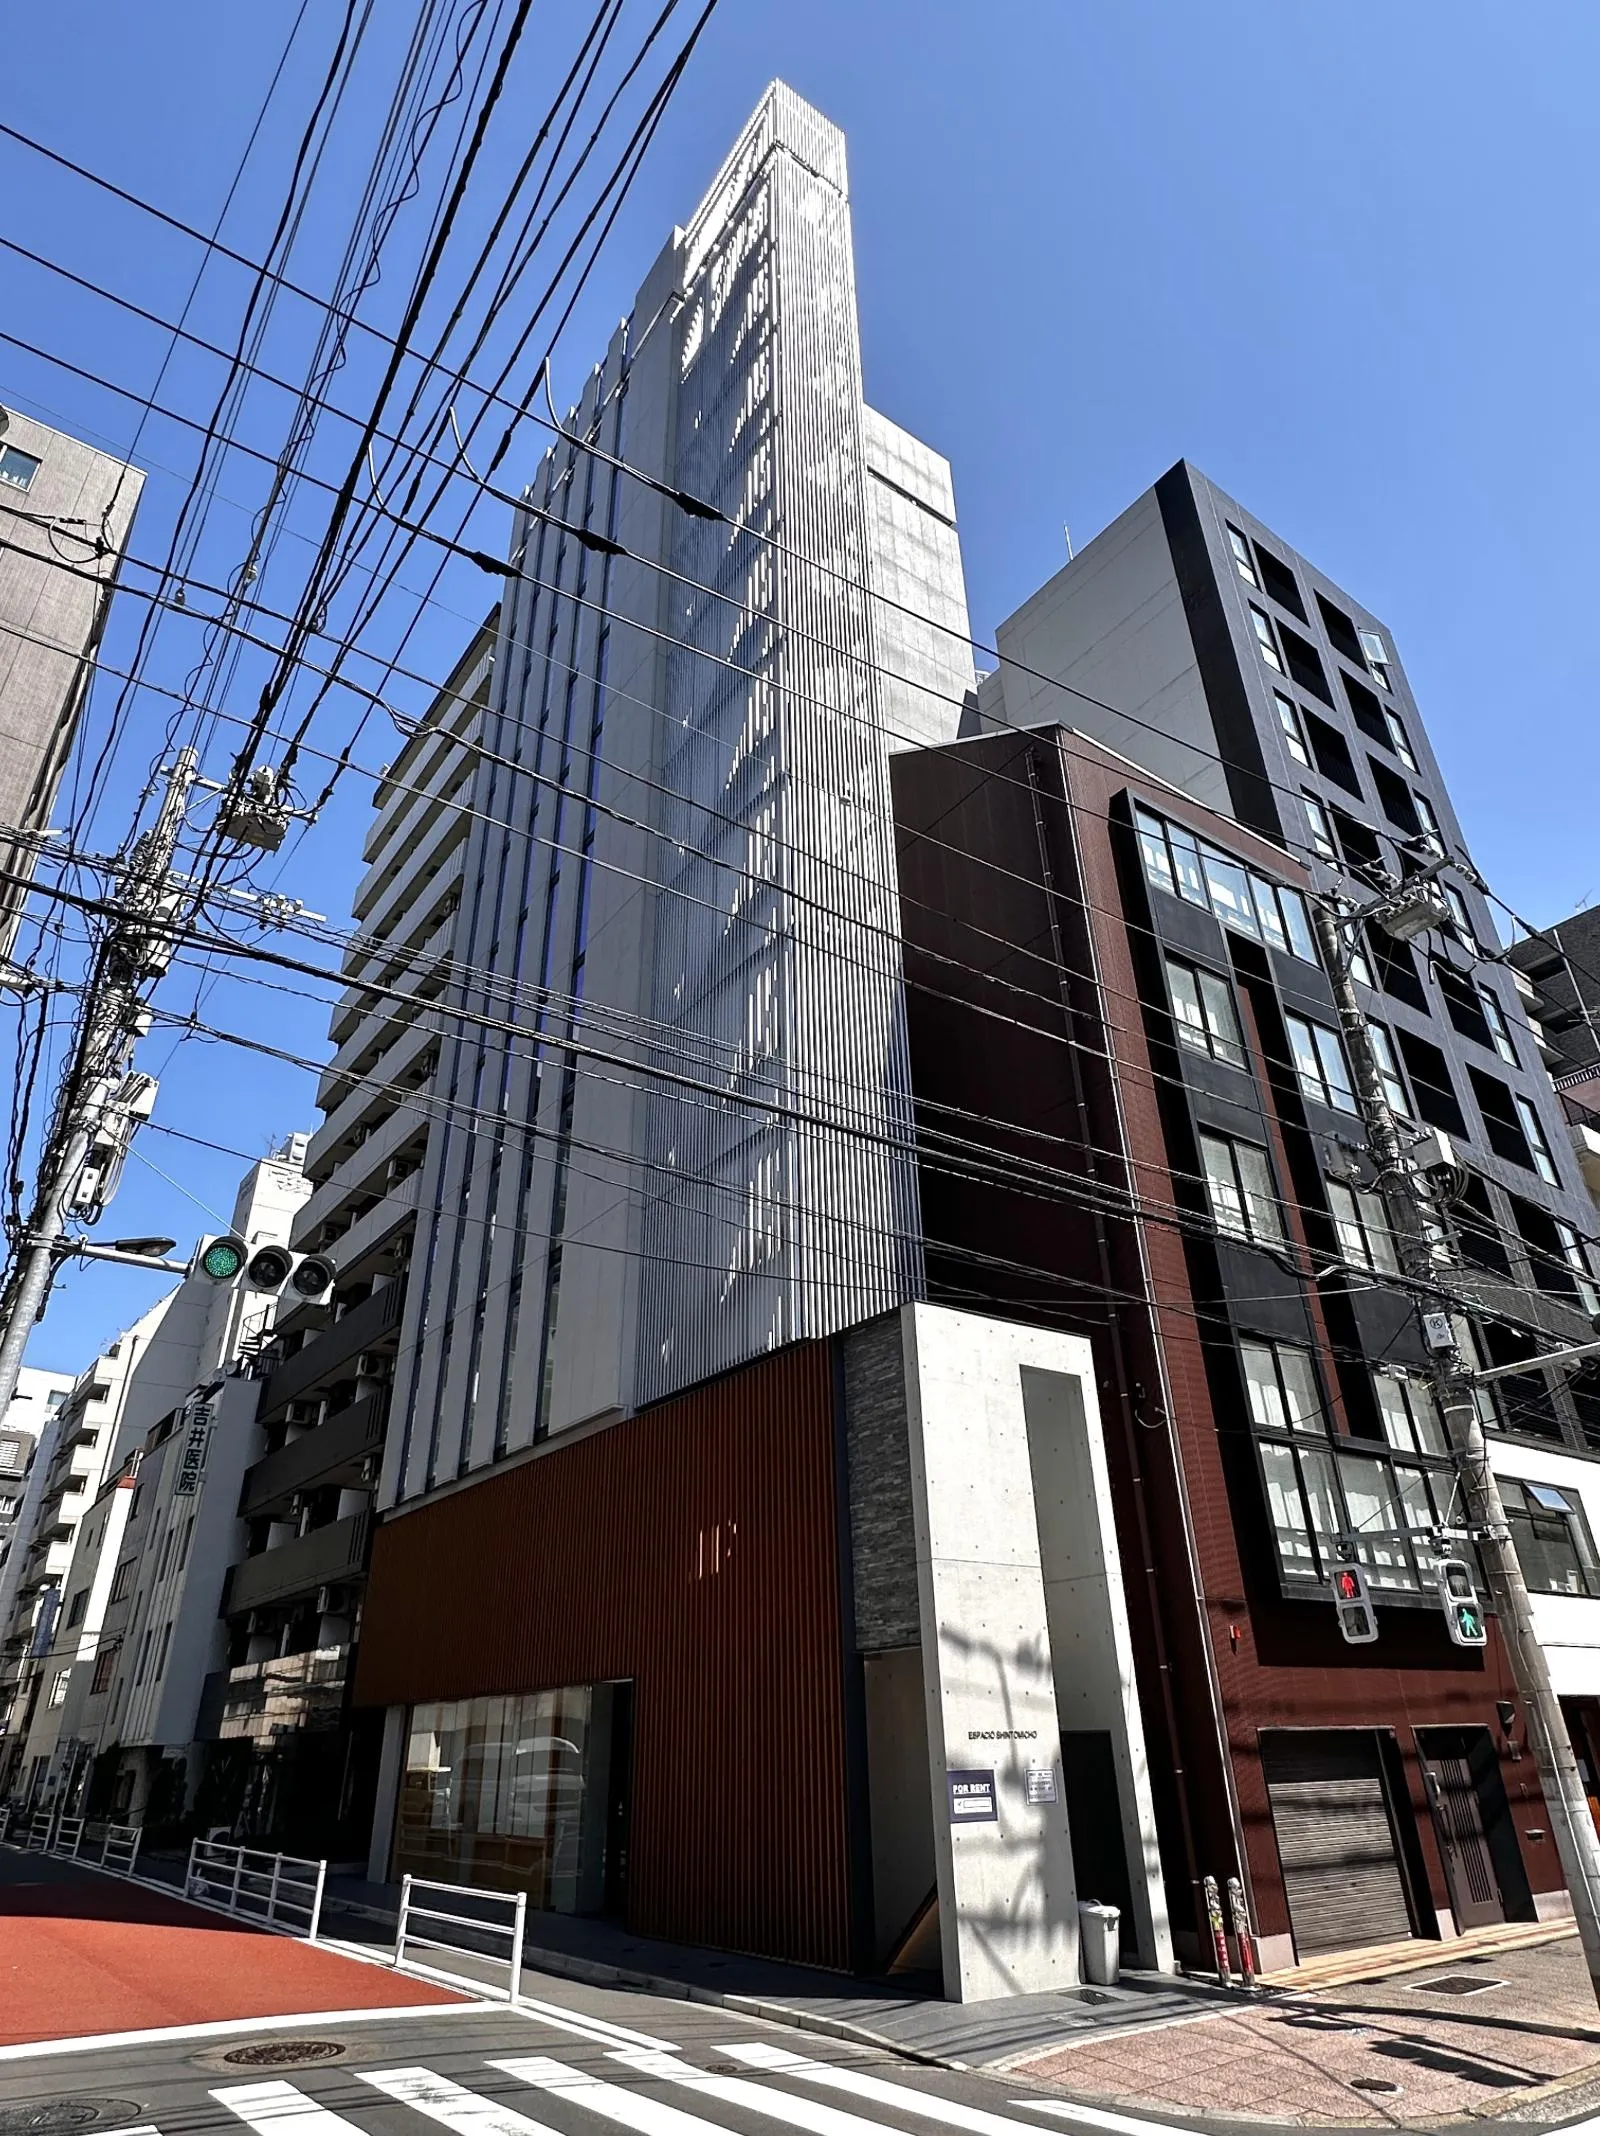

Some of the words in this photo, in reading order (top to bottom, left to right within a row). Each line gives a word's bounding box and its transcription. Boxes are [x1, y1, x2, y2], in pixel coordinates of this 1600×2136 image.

[179, 1406, 211, 1492] 吉井医院
[968, 1730, 995, 1740] ESPACIO
[952, 1784, 969, 1795] FOR
[970, 1783, 991, 1794] RENT
